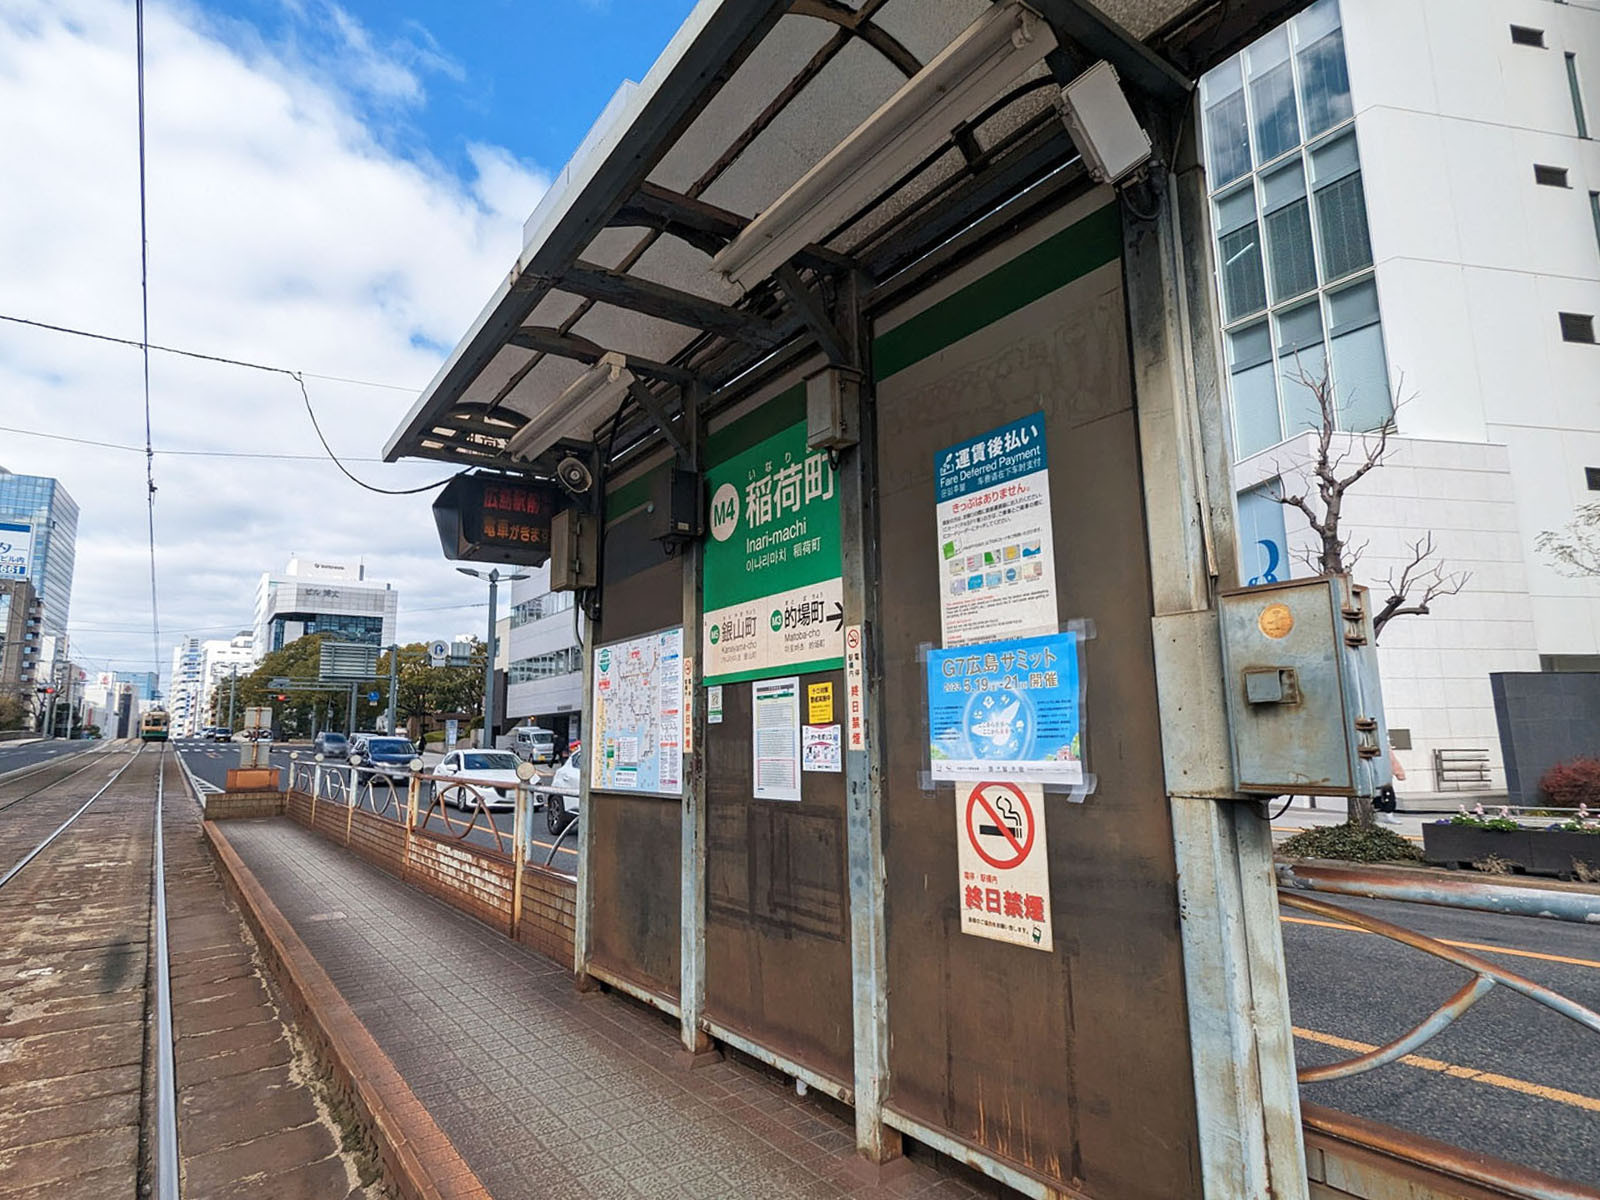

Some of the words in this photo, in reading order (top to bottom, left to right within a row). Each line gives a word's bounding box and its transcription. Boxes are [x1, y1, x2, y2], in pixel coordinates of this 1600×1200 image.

[956, 425, 1039, 469] 運賃後払い
[940, 475, 959, 488] Fare
[960, 461, 997, 481] Deferred
[999, 445, 1041, 467] Payment
[745, 452, 834, 529] 稲荷町
[713, 496, 736, 528] M4
[746, 517, 807, 554] Inari-machi
[745, 547, 787, 573] 이나리마치
[721, 616, 757, 643] 銀山町
[771, 615, 782, 627] M3
[784, 601, 825, 629] 的場町
[784, 629, 821, 642] Matoba-cho
[942, 647, 1057, 677] G7広島サミット
[1029, 671, 1058, 688] 開催
[851, 685, 861, 745] 終日禁煙
[965, 884, 1046, 923] 終日禁煙
